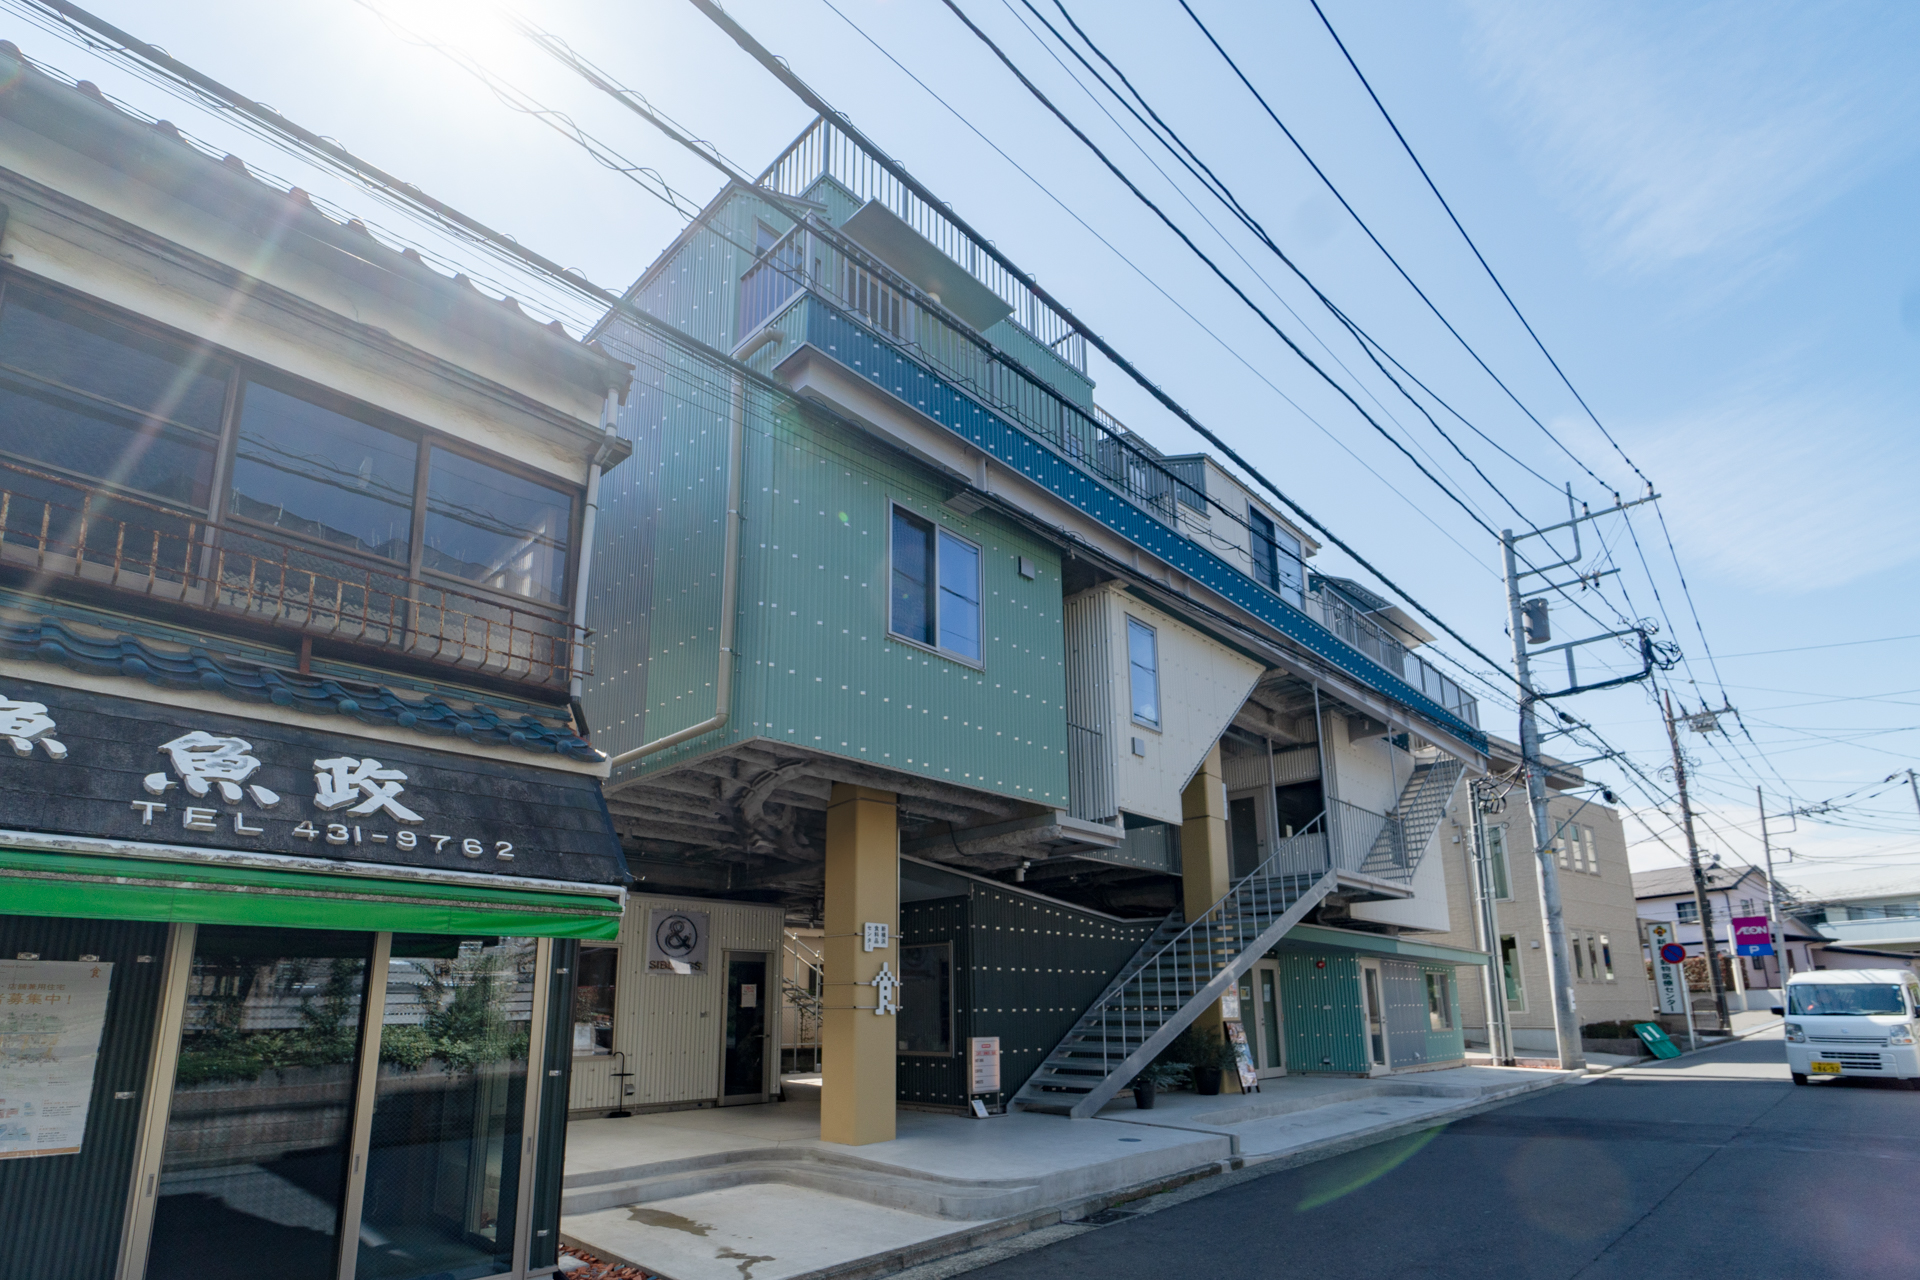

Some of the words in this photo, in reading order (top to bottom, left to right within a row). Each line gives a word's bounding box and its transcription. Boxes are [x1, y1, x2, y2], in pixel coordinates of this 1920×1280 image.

[131, 800, 264, 837] TEL
[292, 820, 515, 861] 431-9762
[1749, 945, 1760, 954] P
